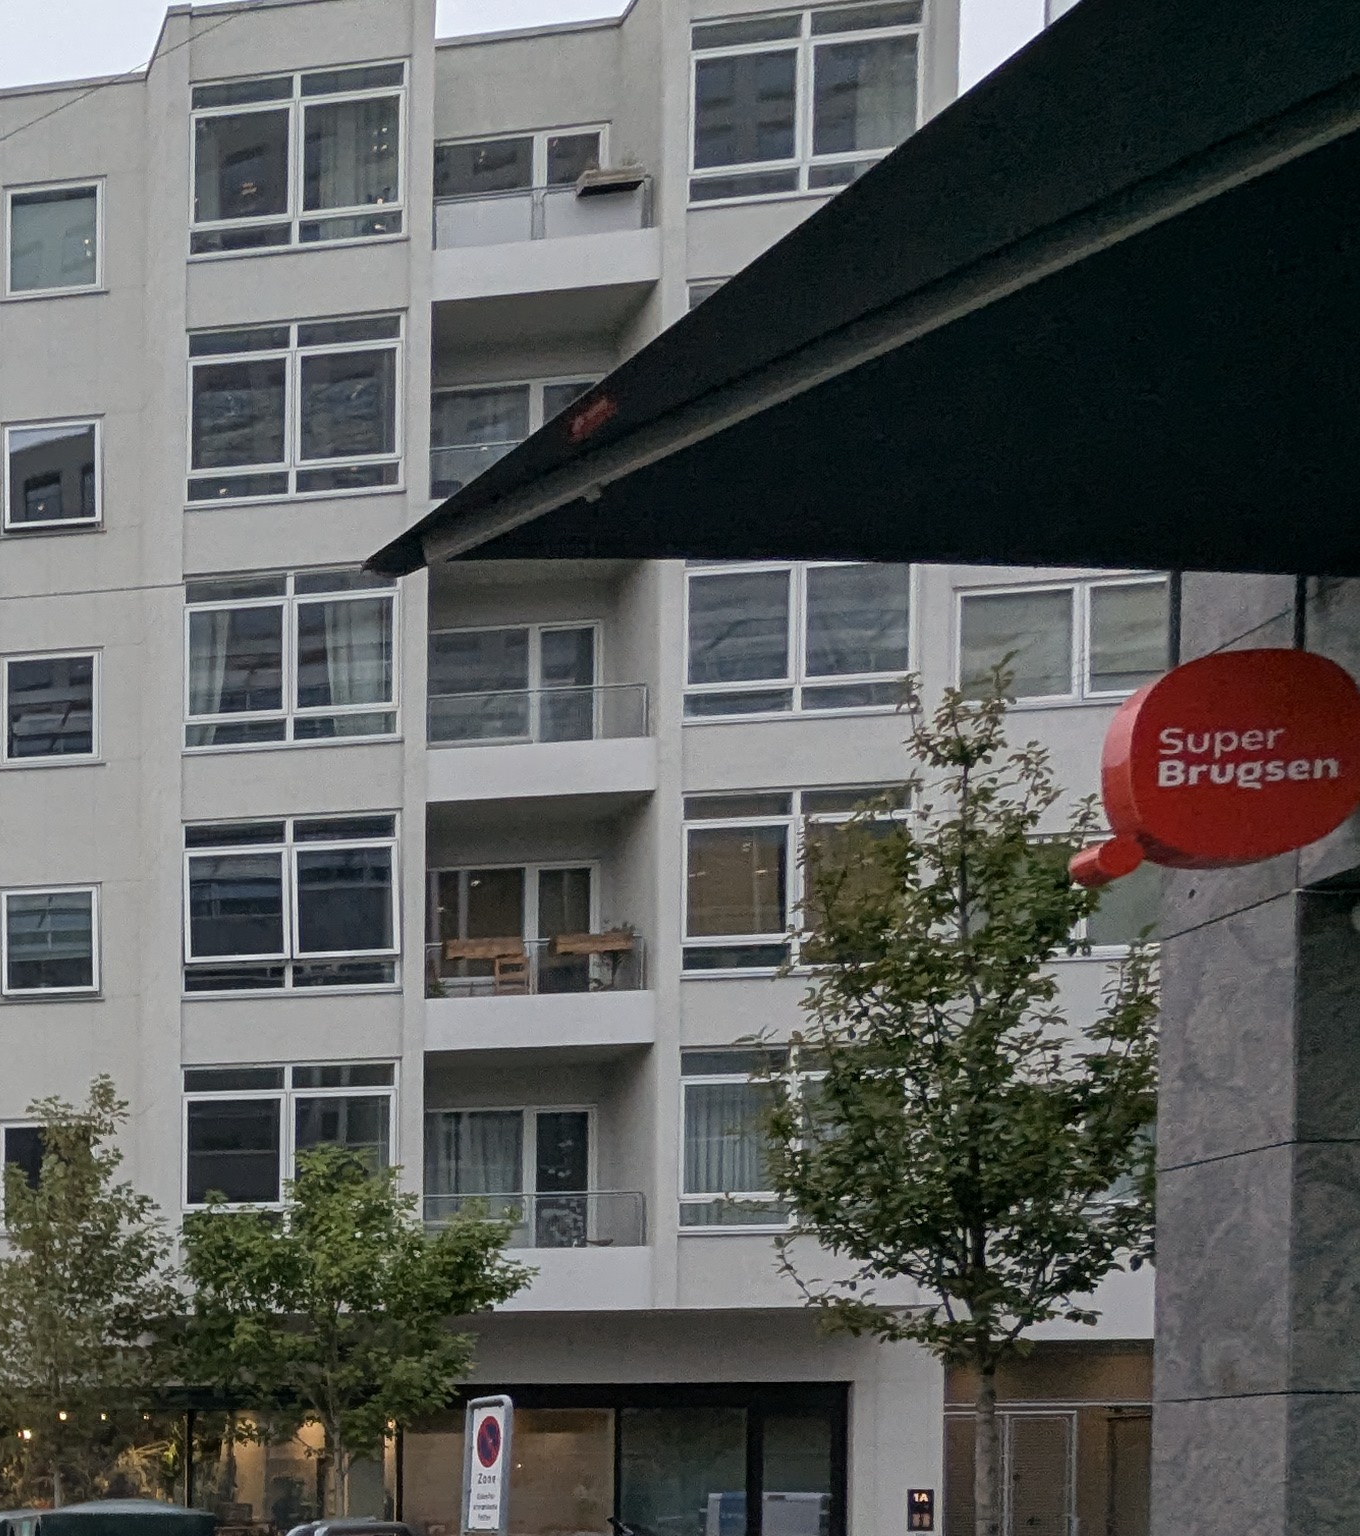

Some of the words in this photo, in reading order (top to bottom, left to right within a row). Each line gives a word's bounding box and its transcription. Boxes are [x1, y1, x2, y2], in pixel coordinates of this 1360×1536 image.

[1158, 727, 1286, 758] Super
[1157, 757, 1341, 790] Brugsen
[477, 1473, 496, 1485] Zone
[913, 1492, 929, 1503] 1A
